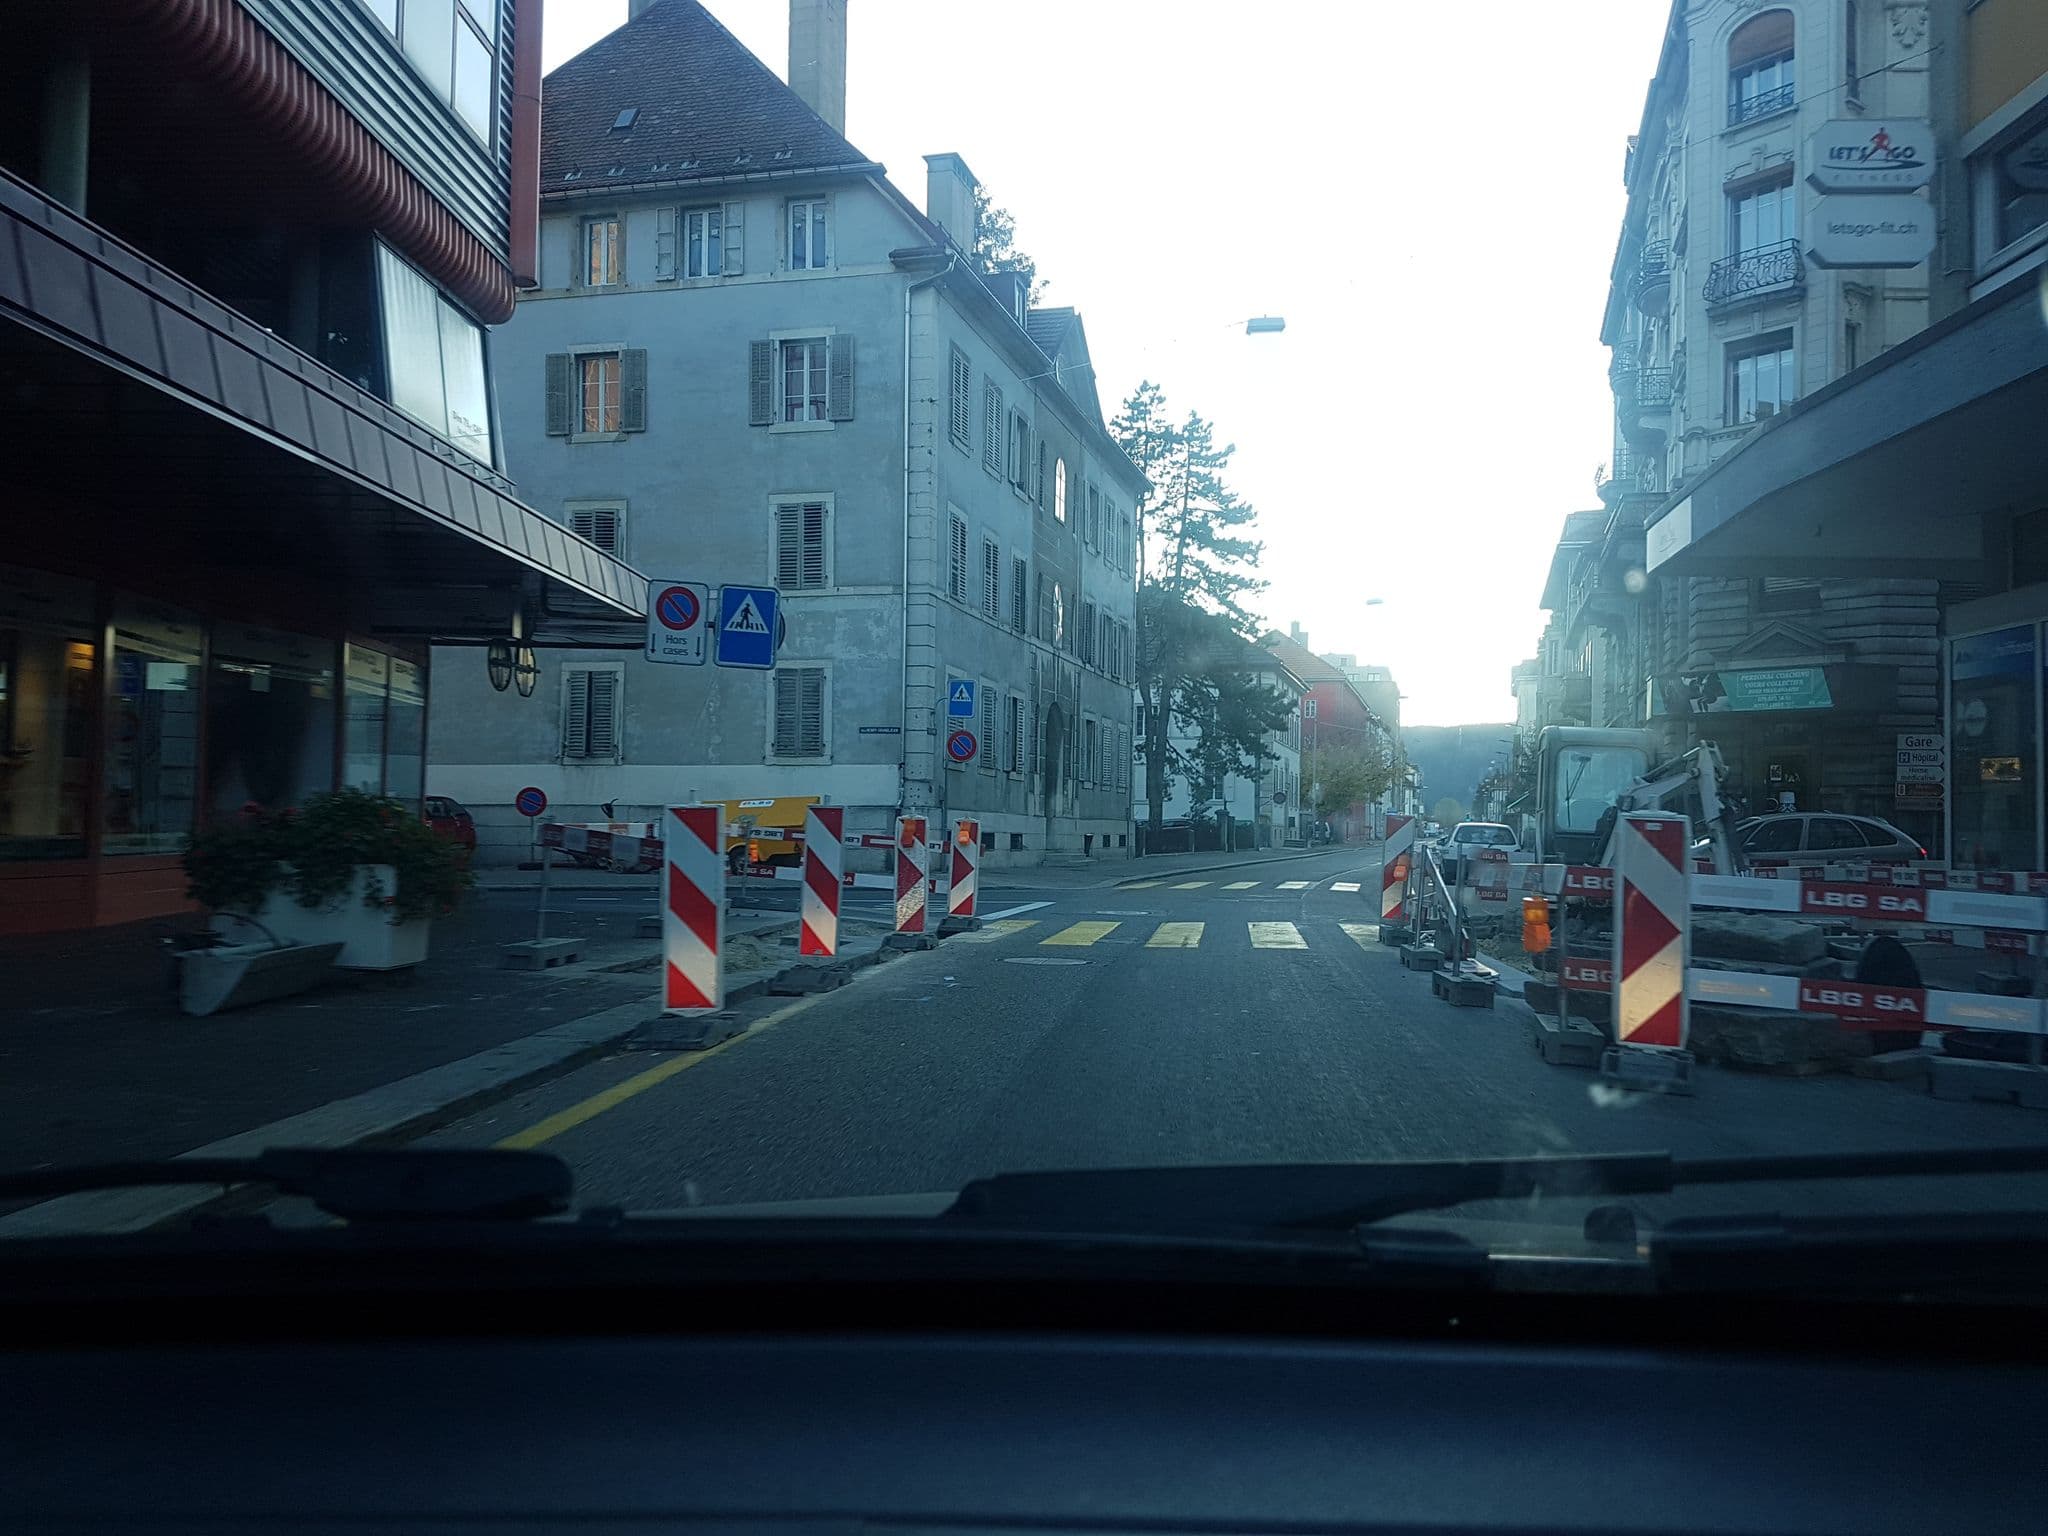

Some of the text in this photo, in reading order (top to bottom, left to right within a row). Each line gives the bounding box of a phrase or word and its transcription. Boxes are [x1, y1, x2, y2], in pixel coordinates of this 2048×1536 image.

[1830, 146, 1916, 160] LET'S GO
[1827, 221, 1918, 237] letsgo-fit.ch
[665, 634, 688, 645] Hors
[663, 647, 689, 656] cases
[1905, 736, 1933, 747] Gare
[1807, 890, 1923, 913] LBG SA
[1802, 988, 1920, 1013] LBG SA
